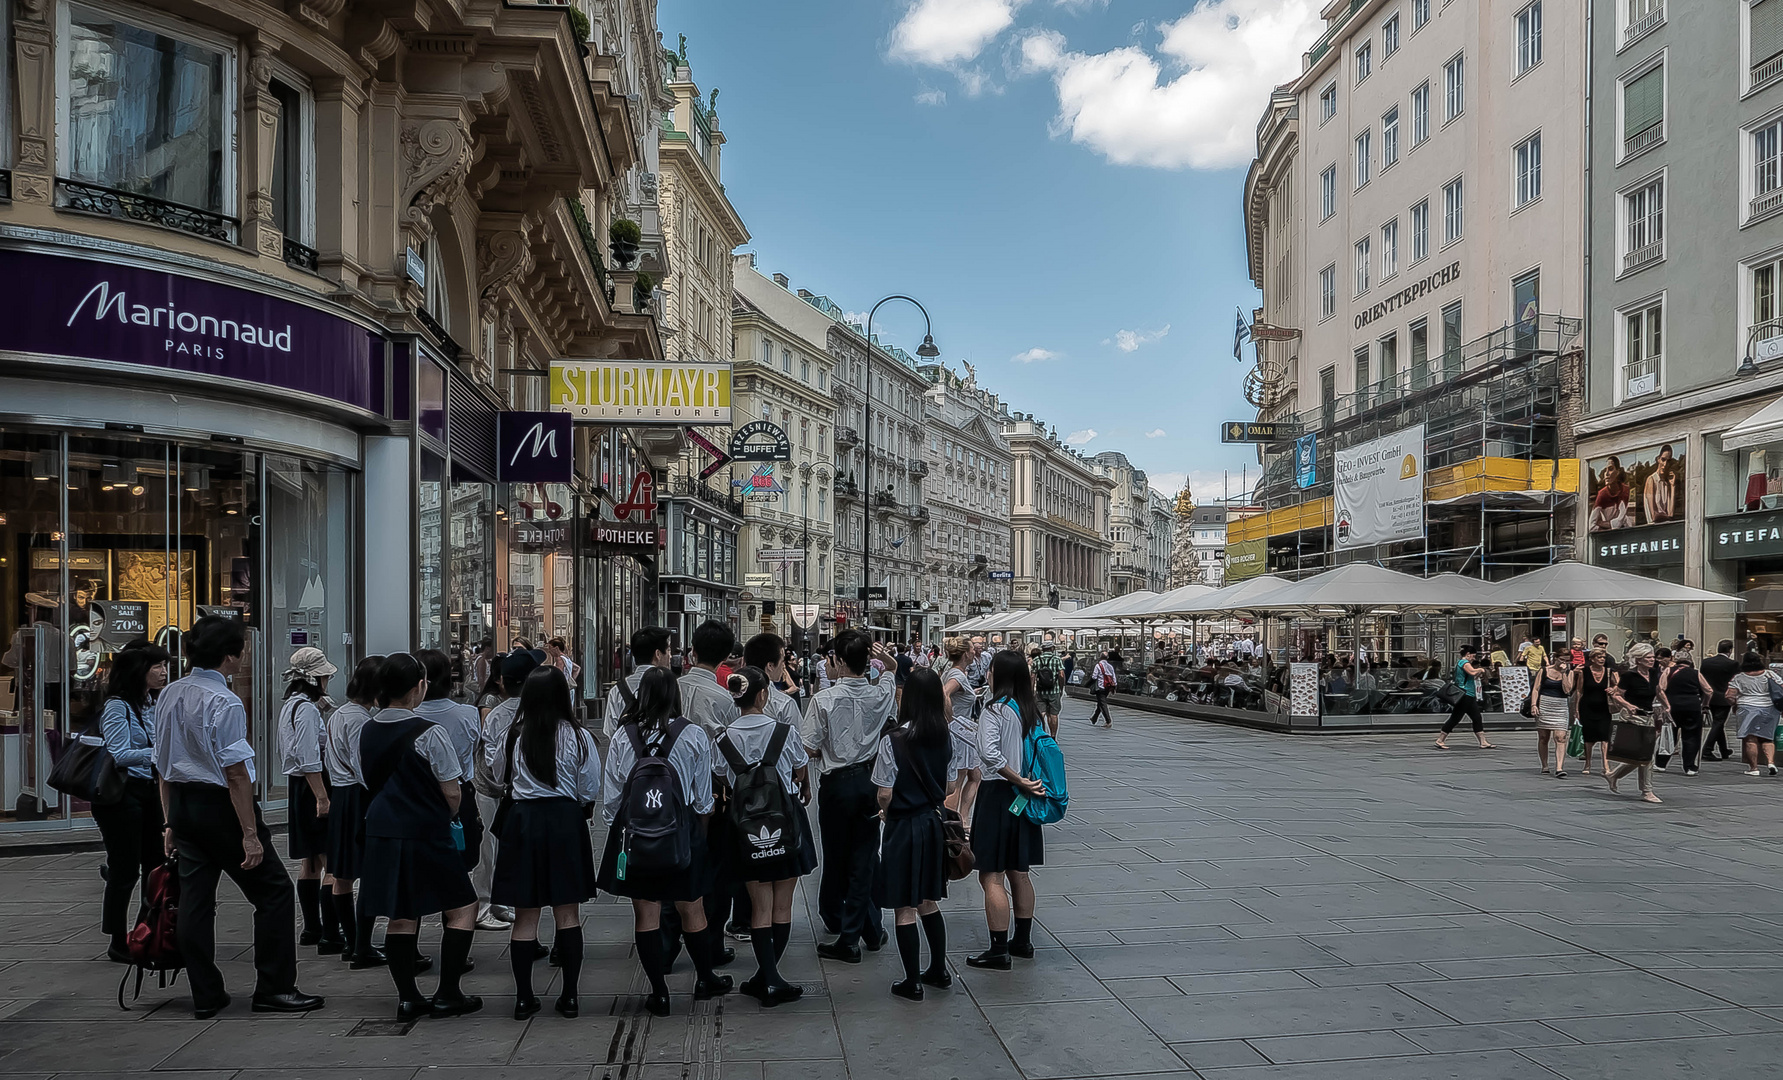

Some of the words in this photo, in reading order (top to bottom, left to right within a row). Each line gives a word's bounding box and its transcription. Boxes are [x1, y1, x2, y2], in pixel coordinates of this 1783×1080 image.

[1354, 260, 1461, 330] ORIENTTEPPICHE
[66, 280, 292, 352] Marionnaud
[164, 338, 225, 361] PARIS
[561, 366, 720, 407] STURMAYR
[561, 407, 720, 417] COIFFEURE
[733, 422, 789, 452] TRZESNIEWSKI
[1247, 426, 1274, 436] OMAR
[743, 445, 778, 453] BUFFET
[1337, 458, 1352, 473] GEO
[1357, 452, 1380, 468] INVEST
[1382, 445, 1402, 461] GmbH
[1718, 527, 1781, 545] STEFA
[1600, 538, 1680, 557] STEFANEL
[751, 845, 786, 860] adidas
